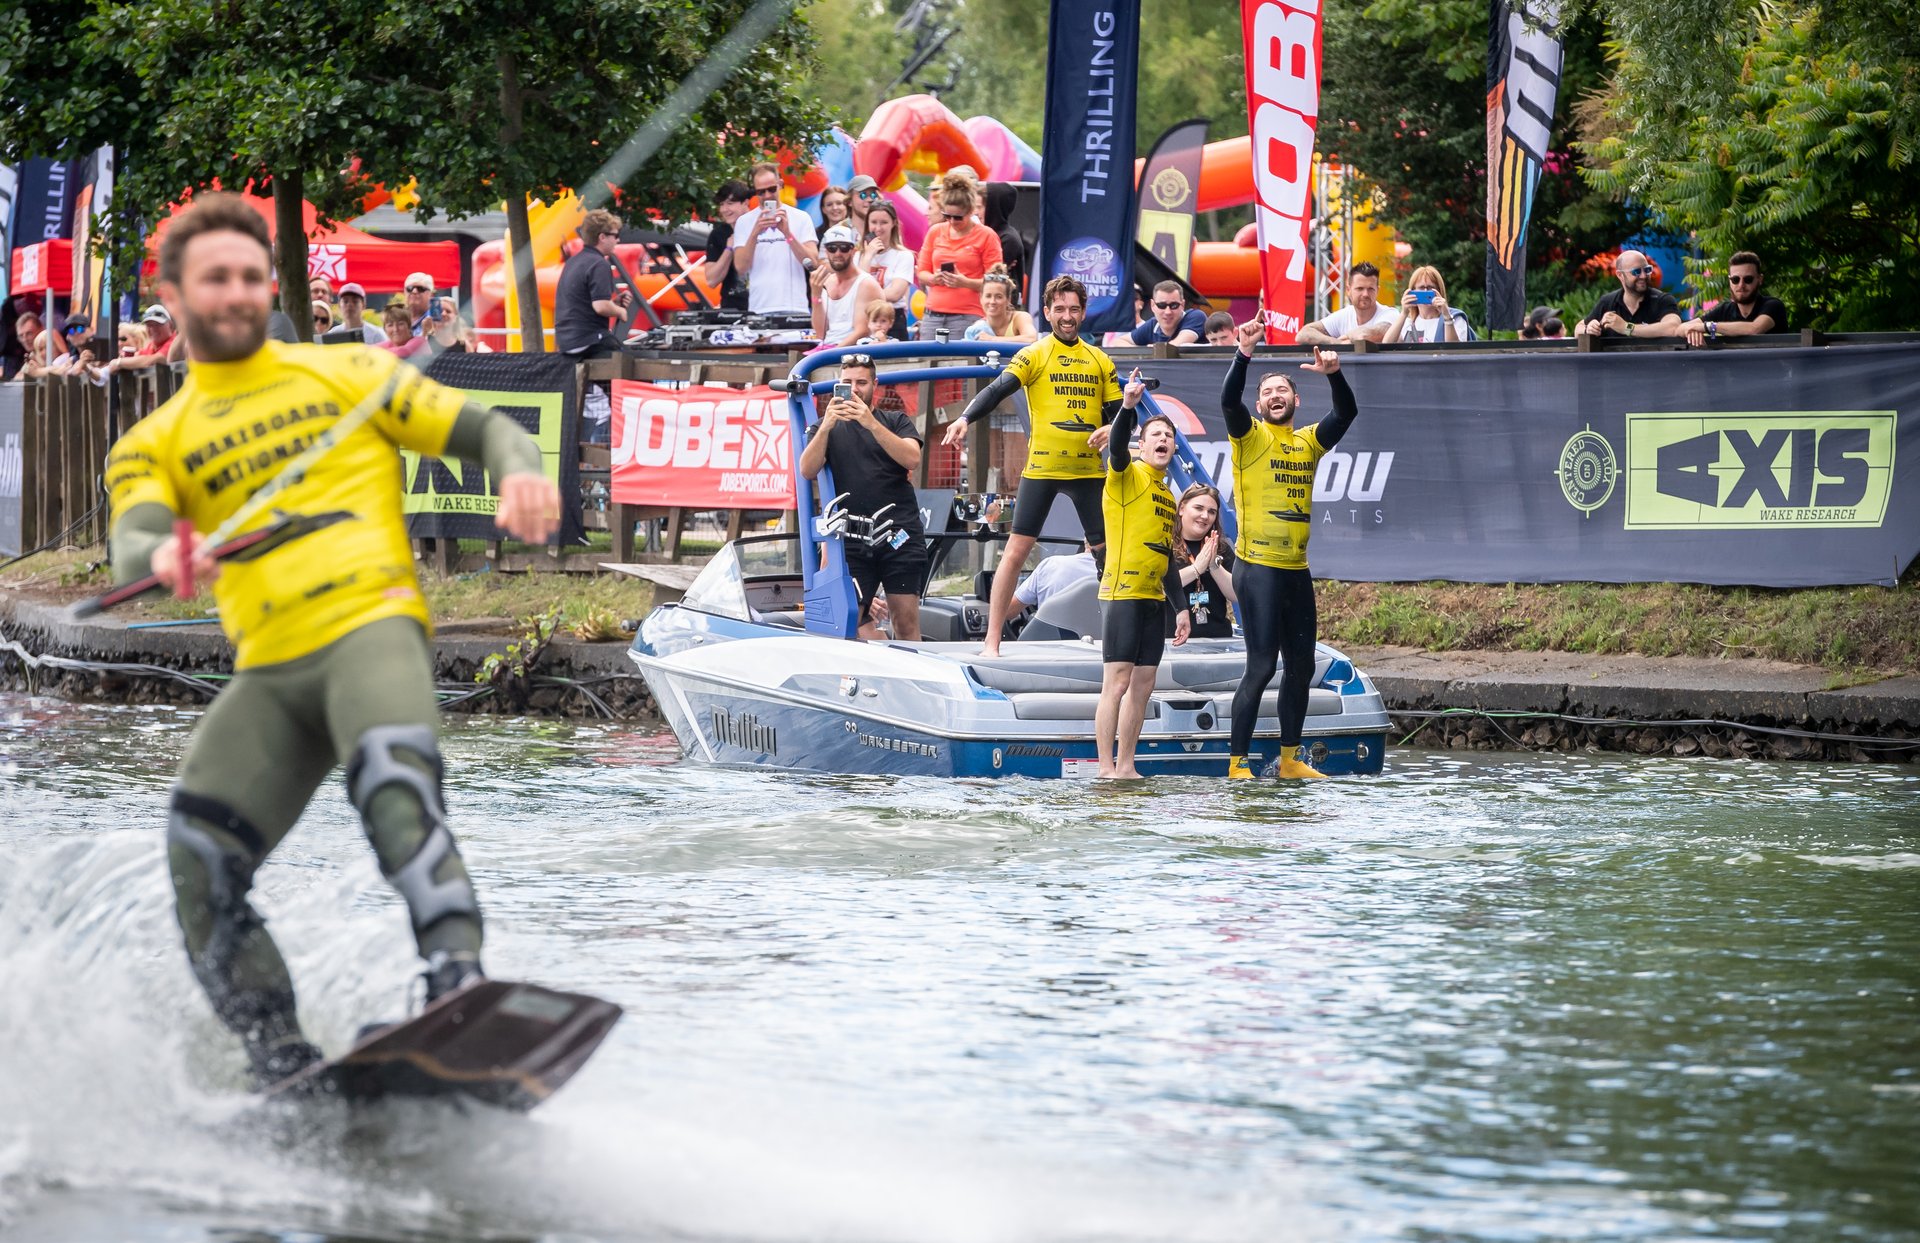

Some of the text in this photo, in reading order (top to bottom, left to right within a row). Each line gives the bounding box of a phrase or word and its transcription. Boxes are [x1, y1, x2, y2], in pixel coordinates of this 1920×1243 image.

[1081, 11, 1116, 203] THRILLING
[1253, 0, 1319, 282] JOB
[1049, 373, 1099, 385] WAKEBOARD
[1054, 386, 1096, 397] NATIONALS
[1066, 399, 1087, 410] 2019
[611, 397, 747, 470] JOBE
[1564, 438, 1586, 503] CENTERED
[1584, 463, 1591, 478] ON
[1602, 455, 1612, 484] YOU
[1656, 428, 1871, 508] AXIS
[718, 472, 788, 493] JOBESPORTS.COM
[1274, 473, 1313, 485] NATIONALS
[1287, 487, 1305, 499] 2019
[433, 496, 473, 511] WAKE
[1759, 508, 1857, 521] WAKE RESEARCH
[711, 703, 777, 756] Malibu
